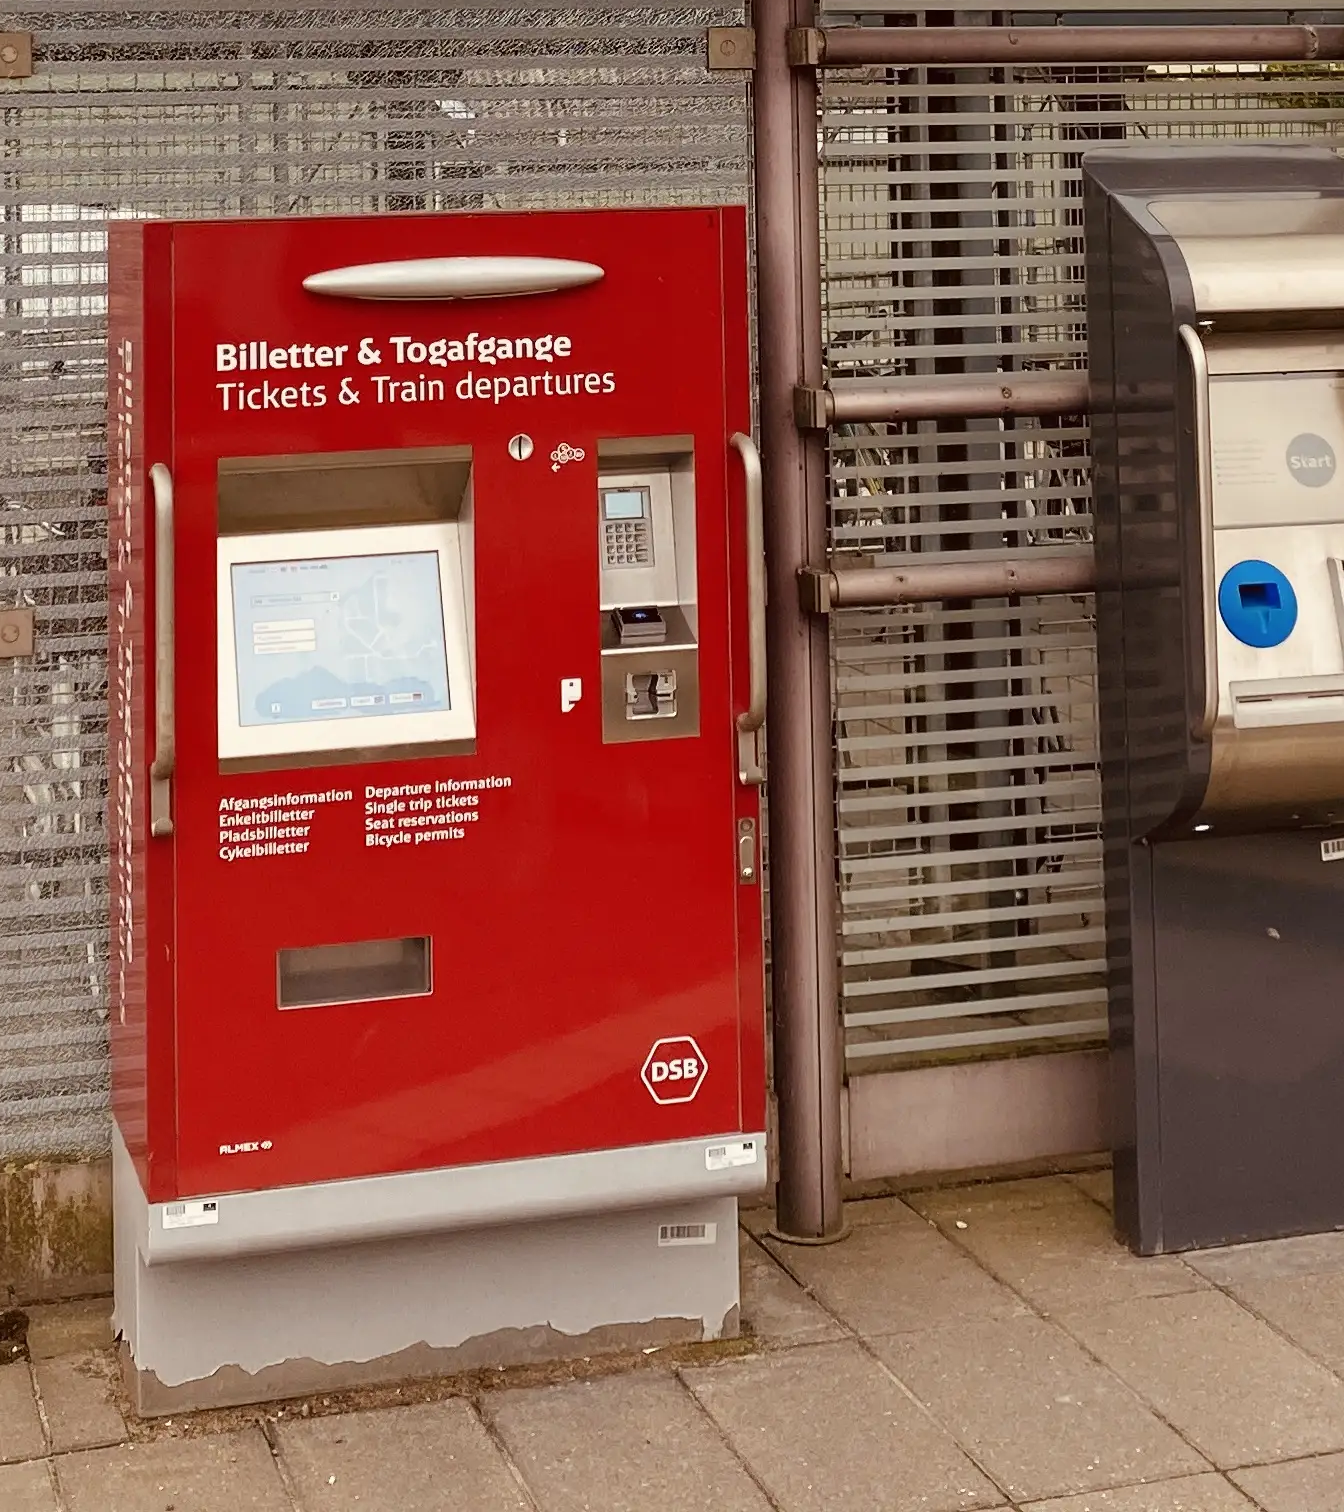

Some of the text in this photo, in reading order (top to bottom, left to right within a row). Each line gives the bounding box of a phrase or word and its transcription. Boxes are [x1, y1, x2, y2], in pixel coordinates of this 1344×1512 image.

[215, 332, 572, 372] Billetter & Togafgange
[216, 370, 616, 411] Tickets & Train departures
[1290, 454, 1332, 469] Start
[364, 775, 512, 802] Departure information
[218, 789, 353, 812] Afgangsinformation
[364, 793, 479, 815] Single trip tickets
[219, 808, 315, 828] Enkeltbilletter
[364, 809, 479, 831] Seat reservations
[219, 824, 311, 844] Pladsbilletter
[365, 826, 465, 849] Bicycle permits
[218, 840, 310, 862] Cykelbilletter
[651, 1057, 699, 1083] DSB
[219, 1141, 259, 1156] ALMEX
